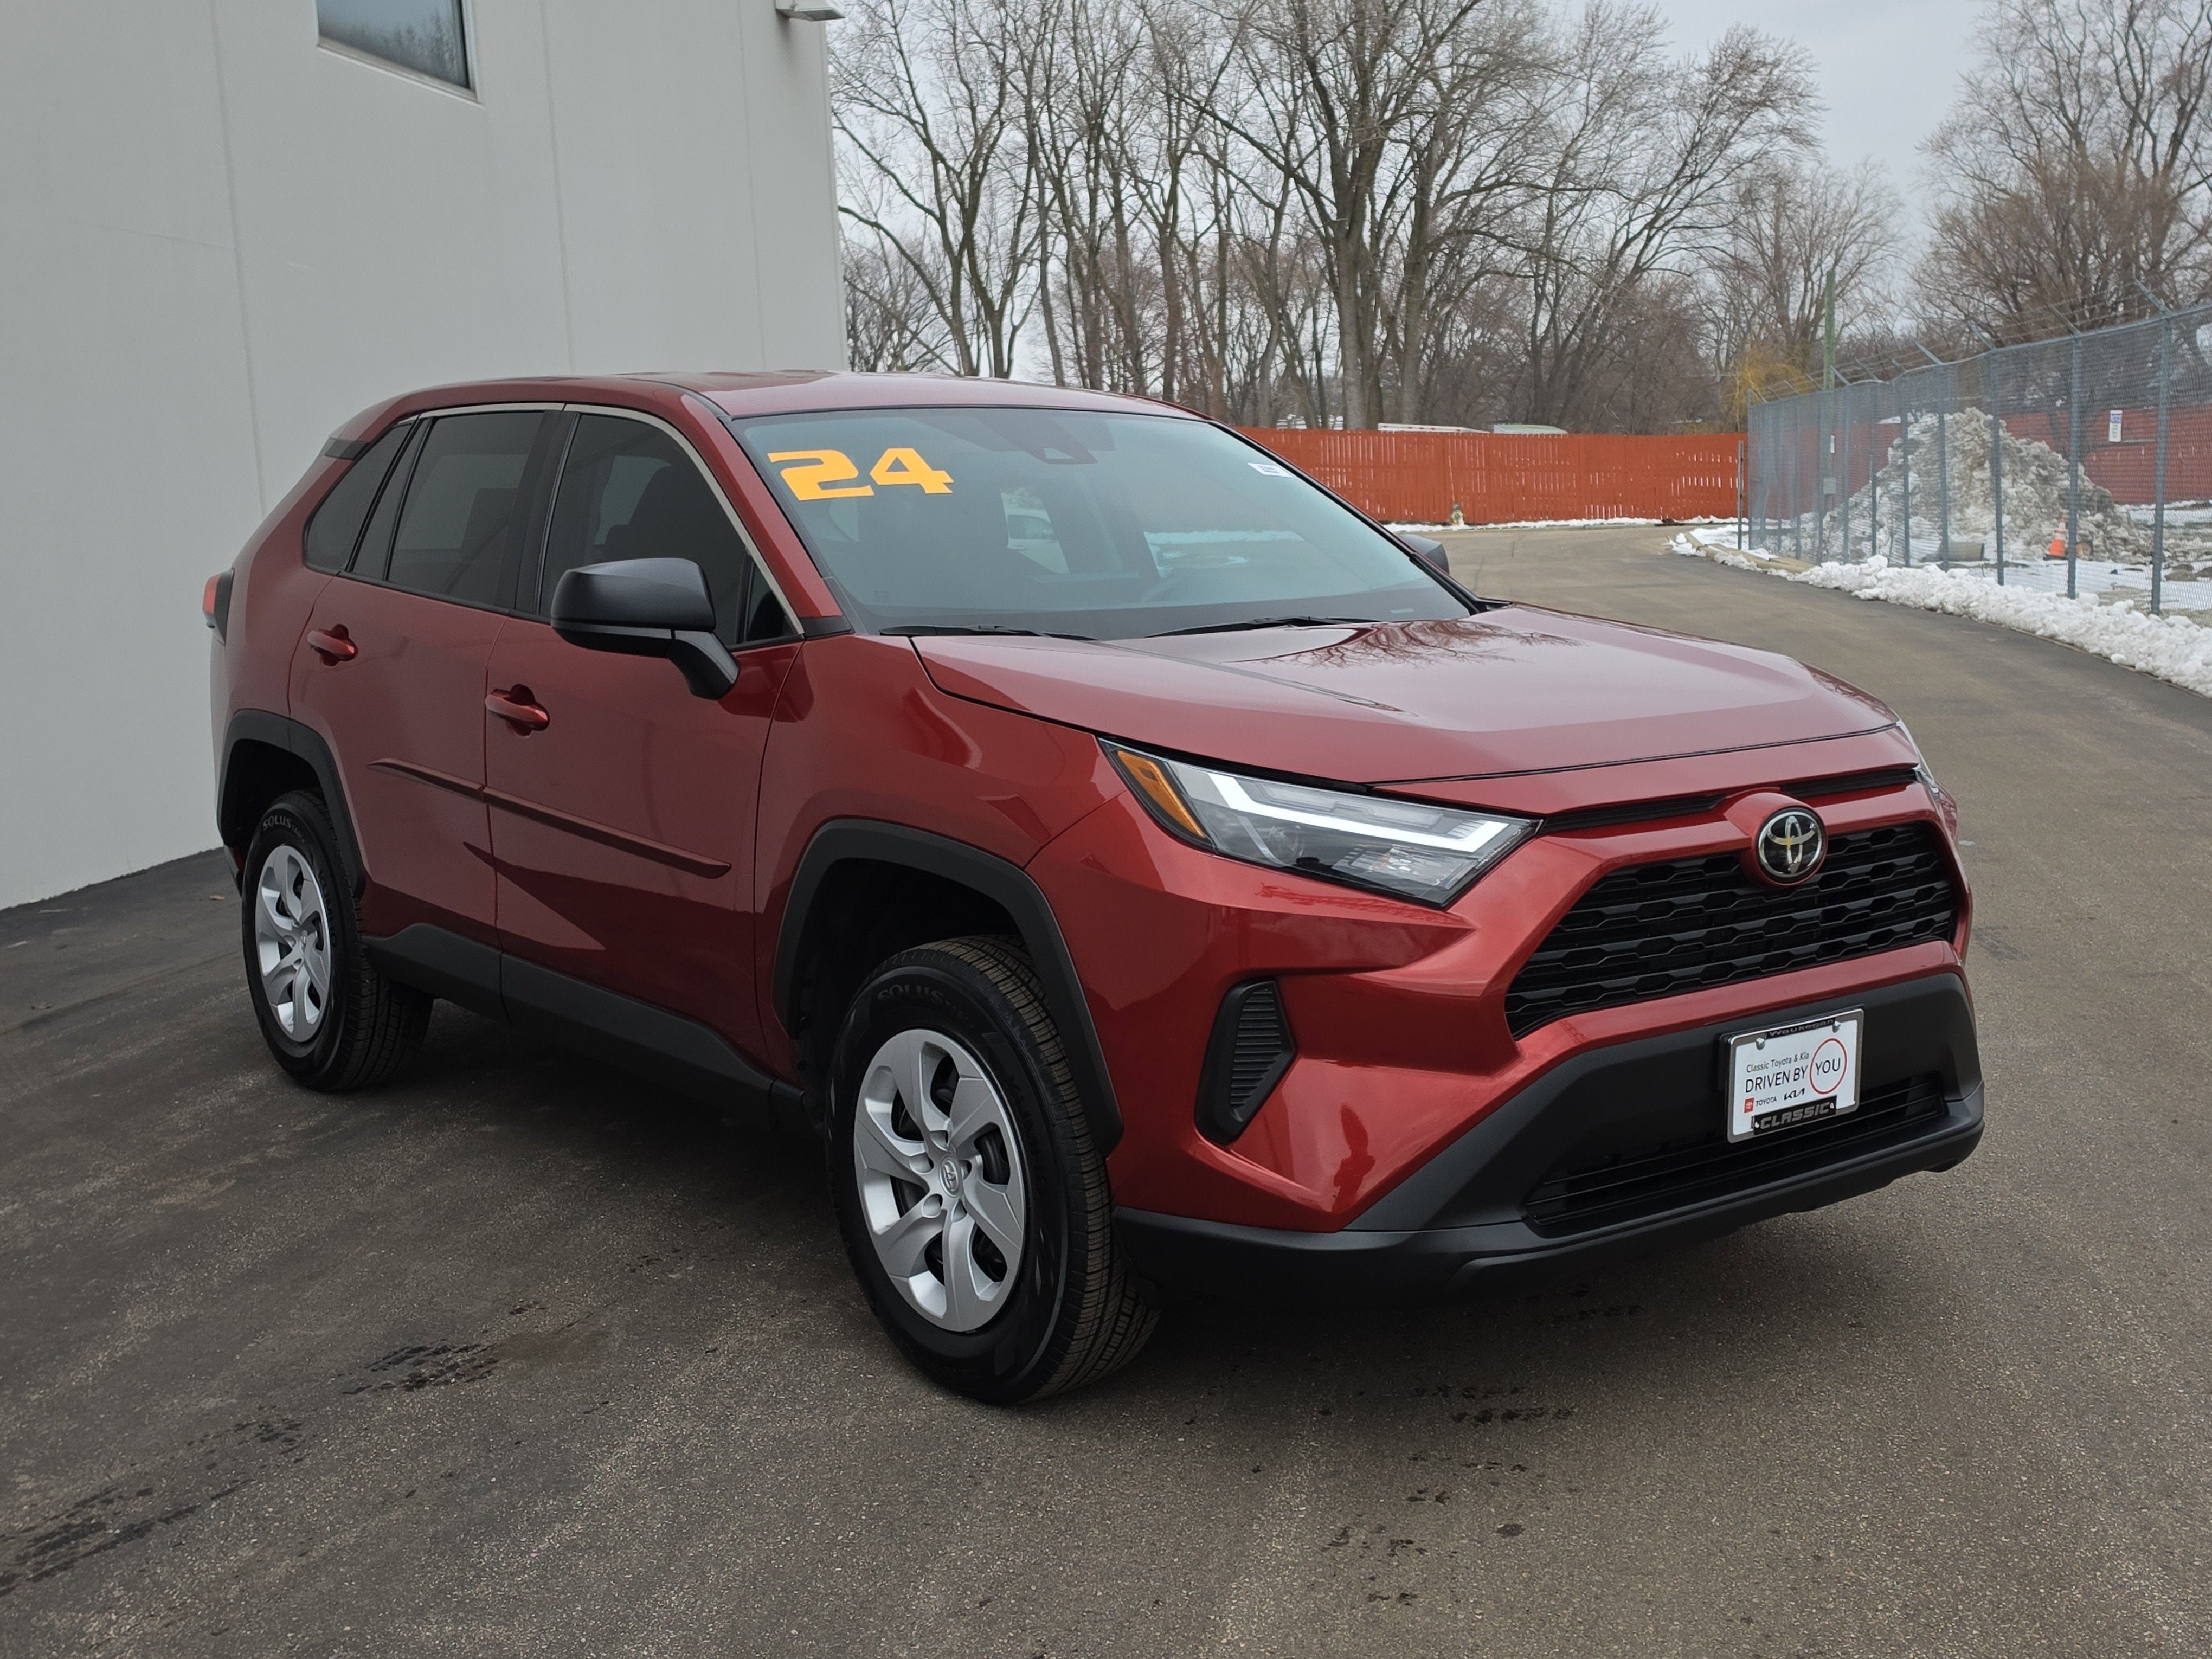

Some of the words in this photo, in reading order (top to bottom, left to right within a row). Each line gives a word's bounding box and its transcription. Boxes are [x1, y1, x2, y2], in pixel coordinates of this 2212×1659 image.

[767, 448, 954, 501] 24
[263, 815, 292, 831] SOLUS
[877, 984, 944, 1006] SOLUS
[1769, 1019, 1834, 1037] Waukegan
[1746, 1061, 1769, 1073] Classic
[1771, 1057, 1792, 1068] Toyota
[1793, 1054, 1798, 1062] &
[1799, 1052, 1809, 1060] Kia
[1745, 1070, 1790, 1093] DRIVEN
[1793, 1065, 1809, 1081] BY
[1815, 1057, 1841, 1075] YOU
[1756, 1096, 1777, 1106] TOYOTA
[1760, 1102, 1830, 1129] CLASSIC
